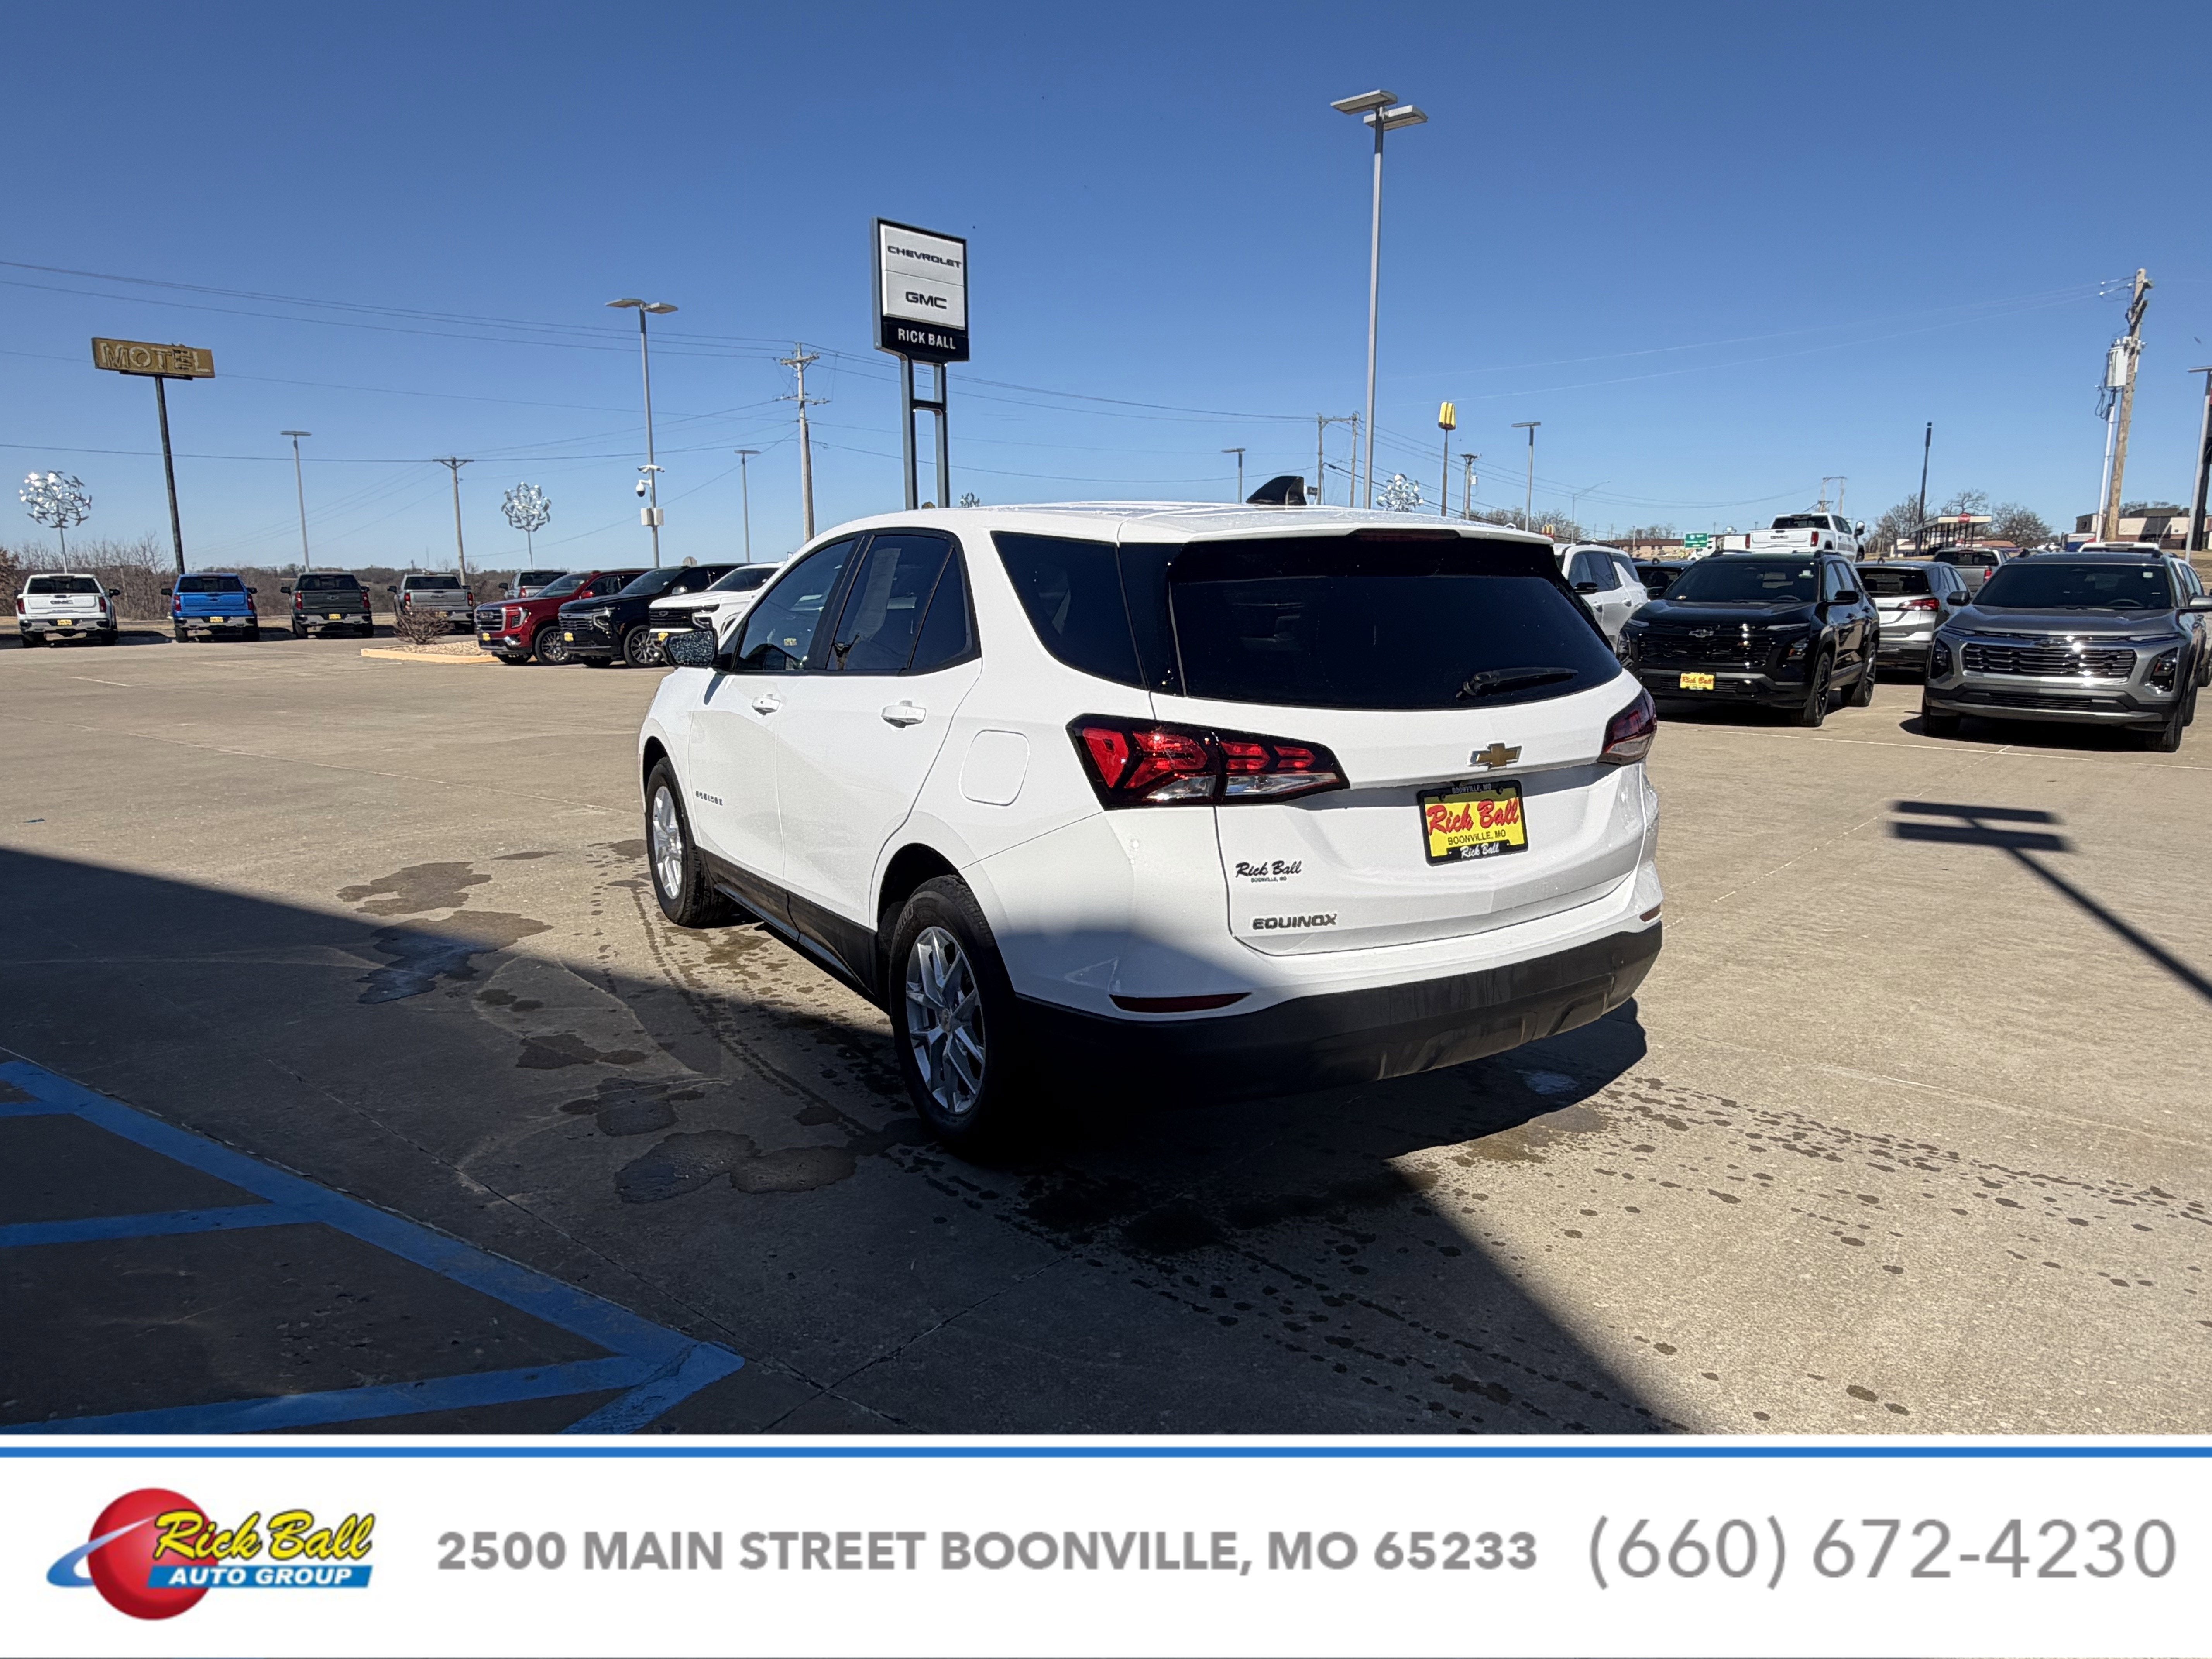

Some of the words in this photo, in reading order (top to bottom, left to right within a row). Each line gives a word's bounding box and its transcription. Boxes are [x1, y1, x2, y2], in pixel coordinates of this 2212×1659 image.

[888, 246, 961, 268] CHEVROLET
[905, 291, 947, 309] GMC
[898, 328, 926, 344] RICK
[928, 333, 956, 349] BALL
[100, 343, 211, 373] MOTEL
[1427, 803, 1474, 836] Rick
[1477, 798, 1519, 828] Ball
[1448, 832, 1493, 845] BOONVILLE,
[1495, 829, 1506, 838] MO
[1460, 844, 1480, 859] Rick
[1481, 842, 1500, 854] Ball
[1235, 861, 1269, 878] Rick
[1272, 860, 1302, 875] Ball
[1253, 913, 1337, 930] EQUINOX
